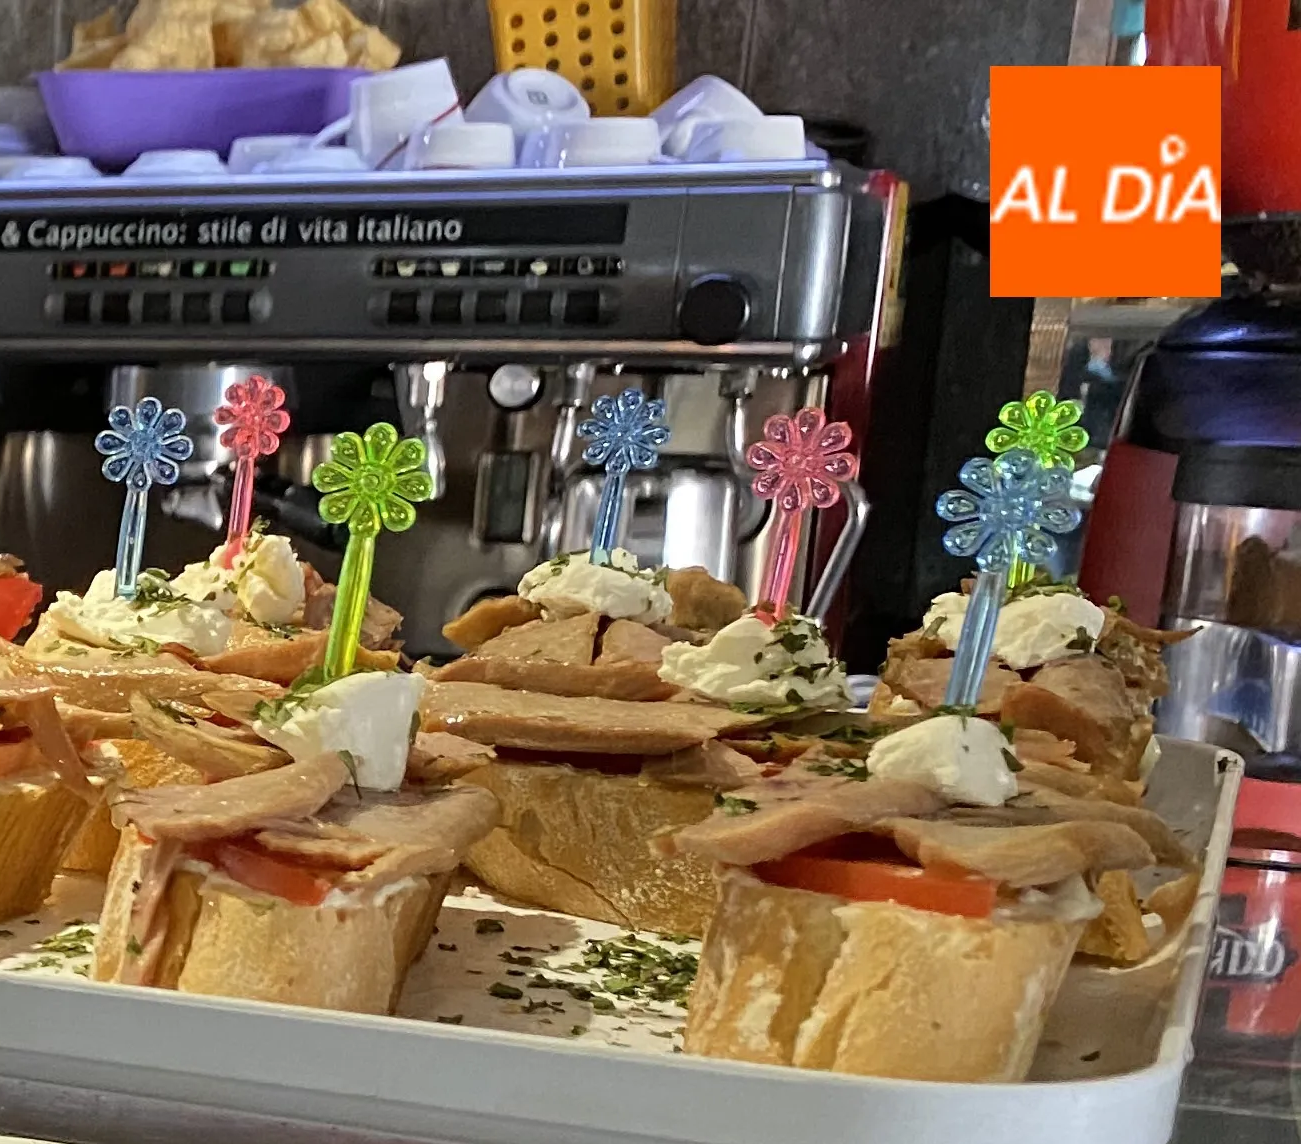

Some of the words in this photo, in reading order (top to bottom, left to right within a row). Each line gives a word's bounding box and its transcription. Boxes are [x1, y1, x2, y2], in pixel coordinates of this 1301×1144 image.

[0, 220, 21, 249] &
[27, 218, 187, 251] Cappuccino:
[197, 215, 252, 245] stile
[260, 215, 287, 244] di
[298, 215, 347, 243] vita
[357, 213, 463, 242] italiano
